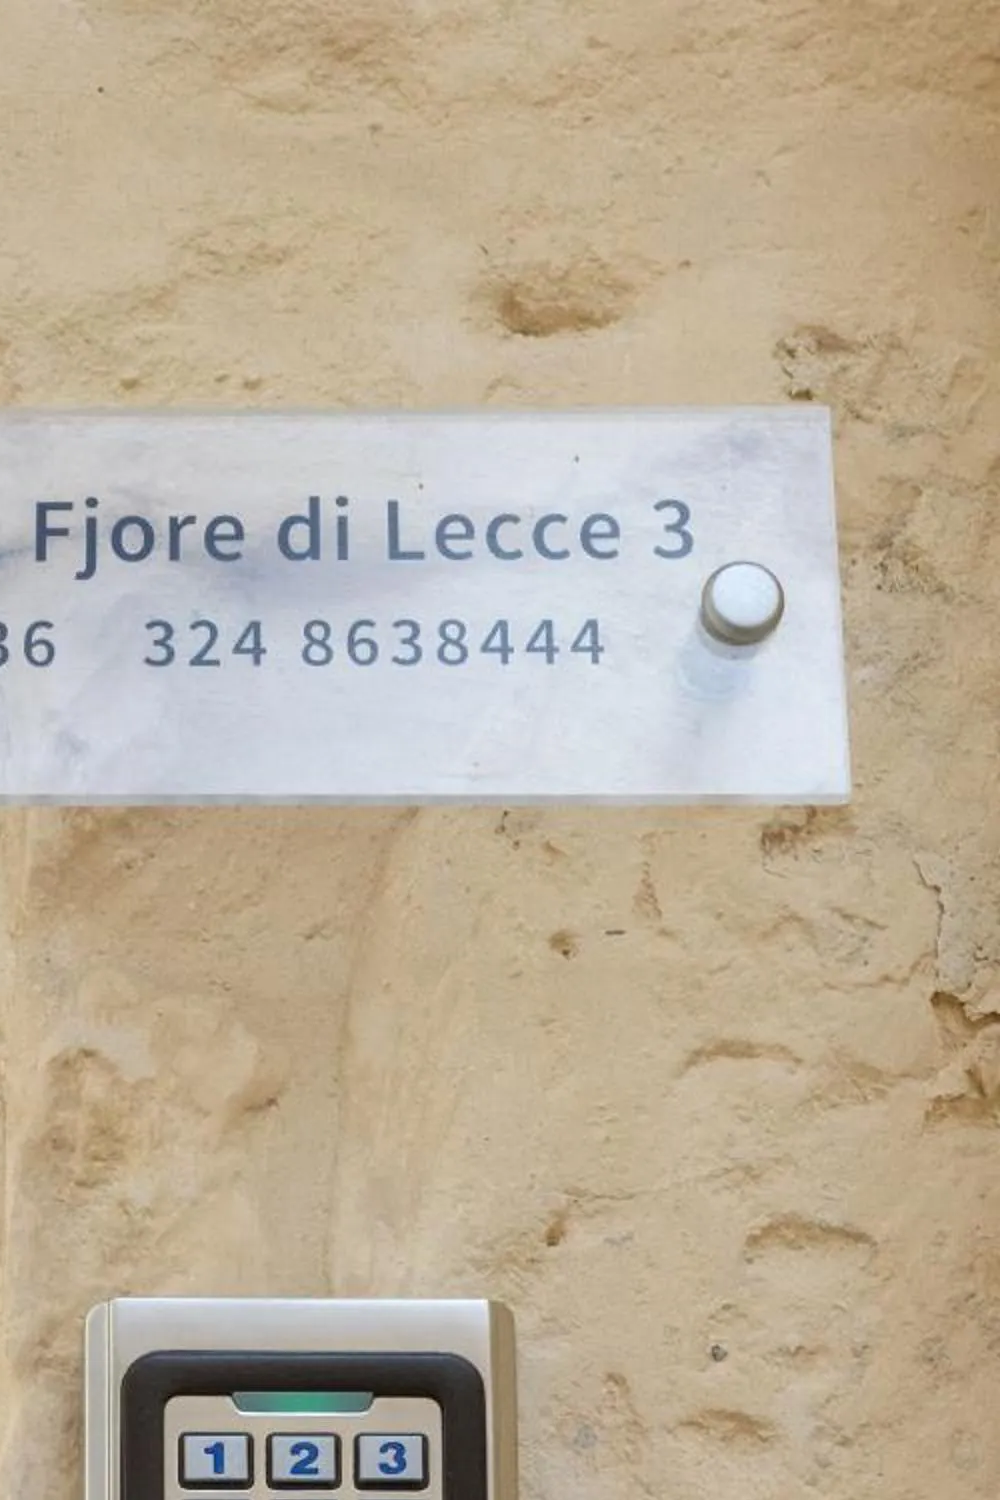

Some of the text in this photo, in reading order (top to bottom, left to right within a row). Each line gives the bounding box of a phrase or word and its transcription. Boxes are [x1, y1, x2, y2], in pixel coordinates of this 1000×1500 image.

[35, 497, 244, 580] Fjore
[278, 496, 348, 561] di
[388, 500, 620, 560] Lecce
[654, 499, 693, 559] 3
[144, 620, 267, 667] 324
[302, 619, 604, 666] 8638444
[204, 1441, 407, 1475] 1 2 3
